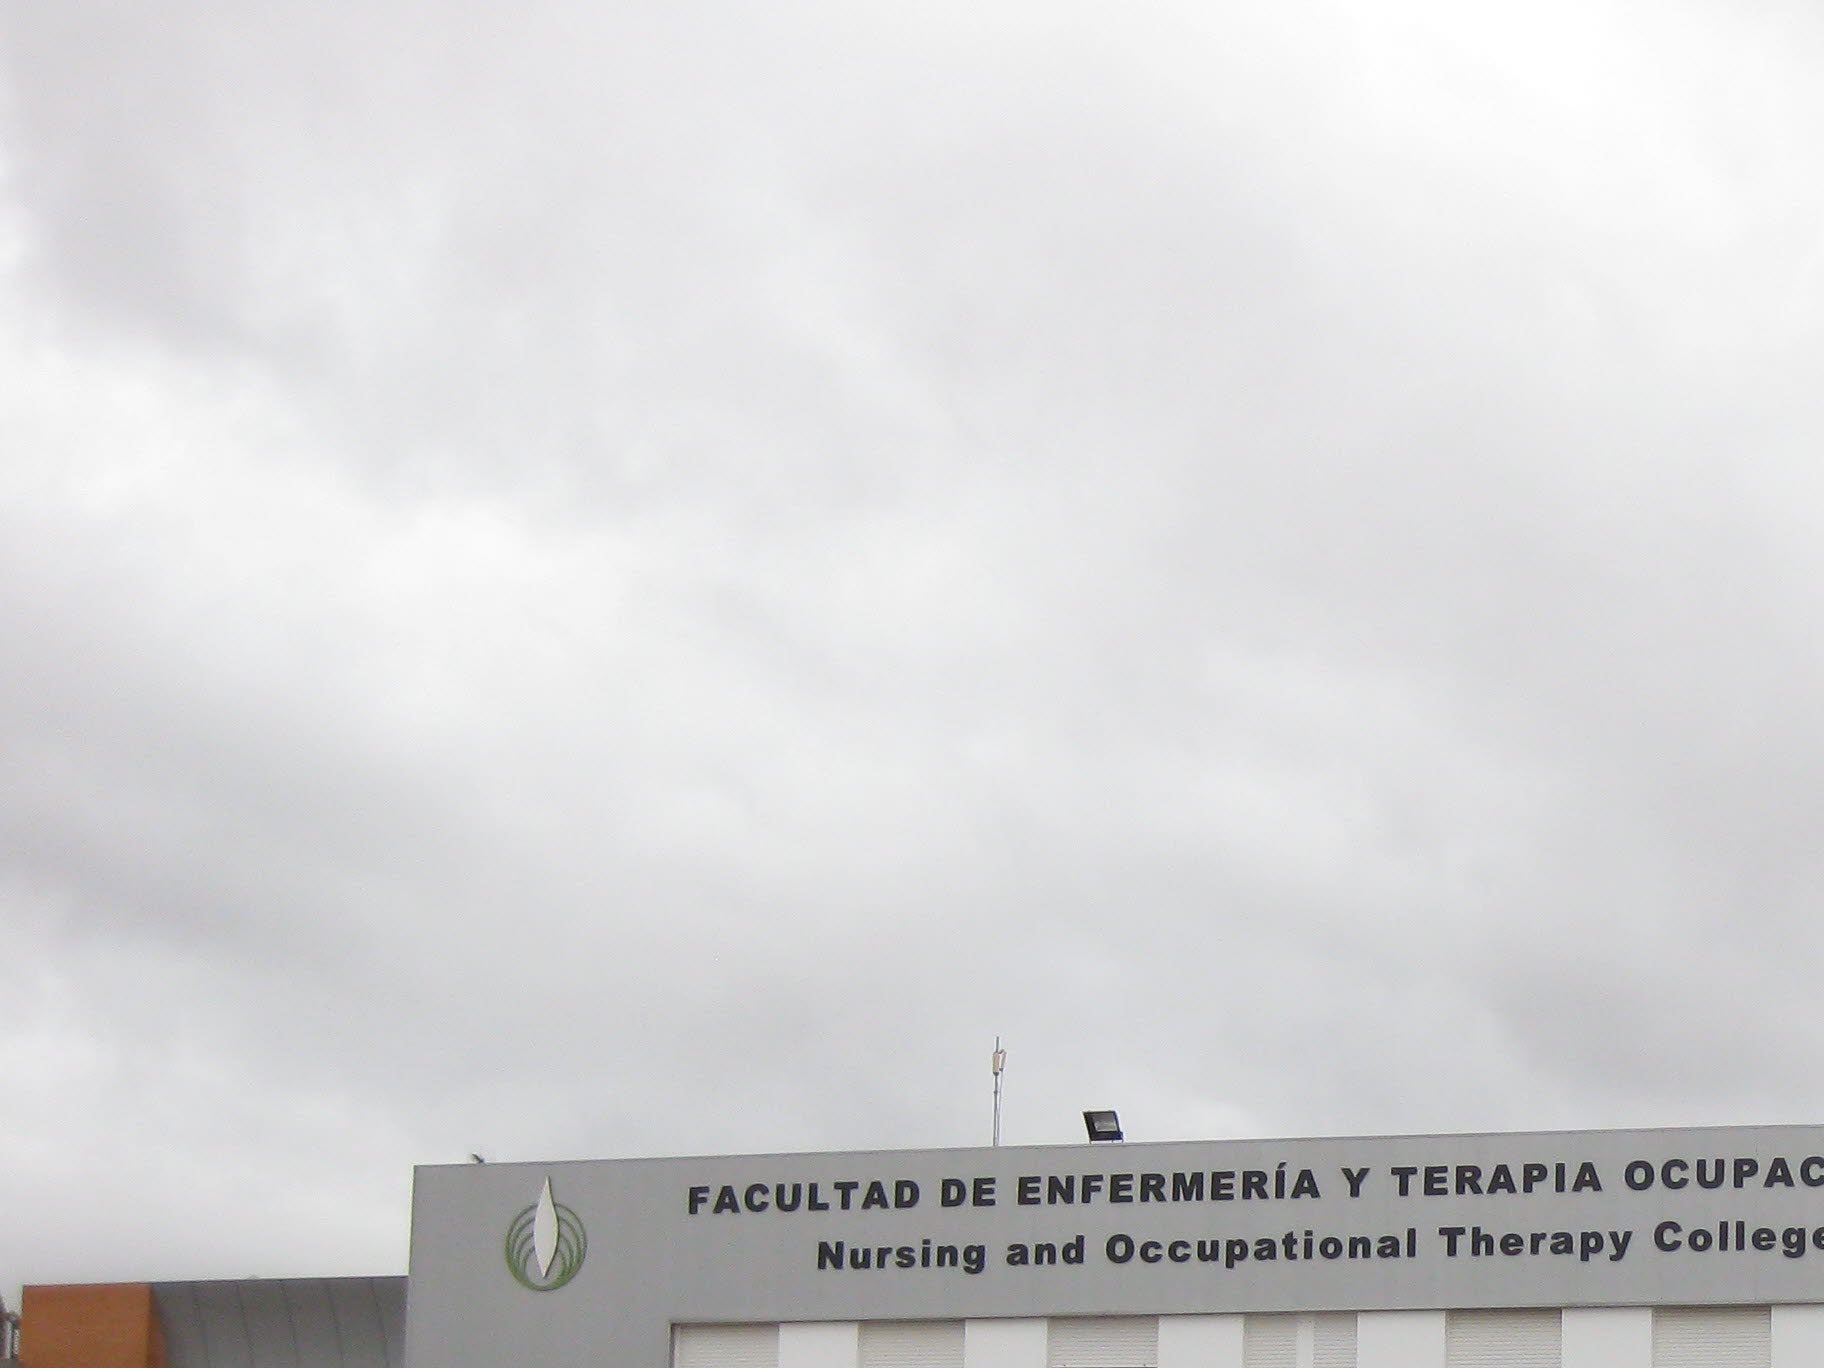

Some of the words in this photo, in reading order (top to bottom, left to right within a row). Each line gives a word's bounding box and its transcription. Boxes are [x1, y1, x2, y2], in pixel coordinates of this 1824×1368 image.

[688, 1179, 920, 1215] FACULTAD
[940, 1177, 996, 1208] DE
[1017, 1161, 1321, 1206] ENFERMERÍA
[1340, 1167, 1371, 1198] Y
[1390, 1161, 1603, 1197] TERAPIA
[817, 1238, 986, 1275] Nursing
[1005, 1234, 1085, 1267] and
[1105, 1227, 1417, 1270] Occupational
[1438, 1226, 1633, 1262] Therapy
